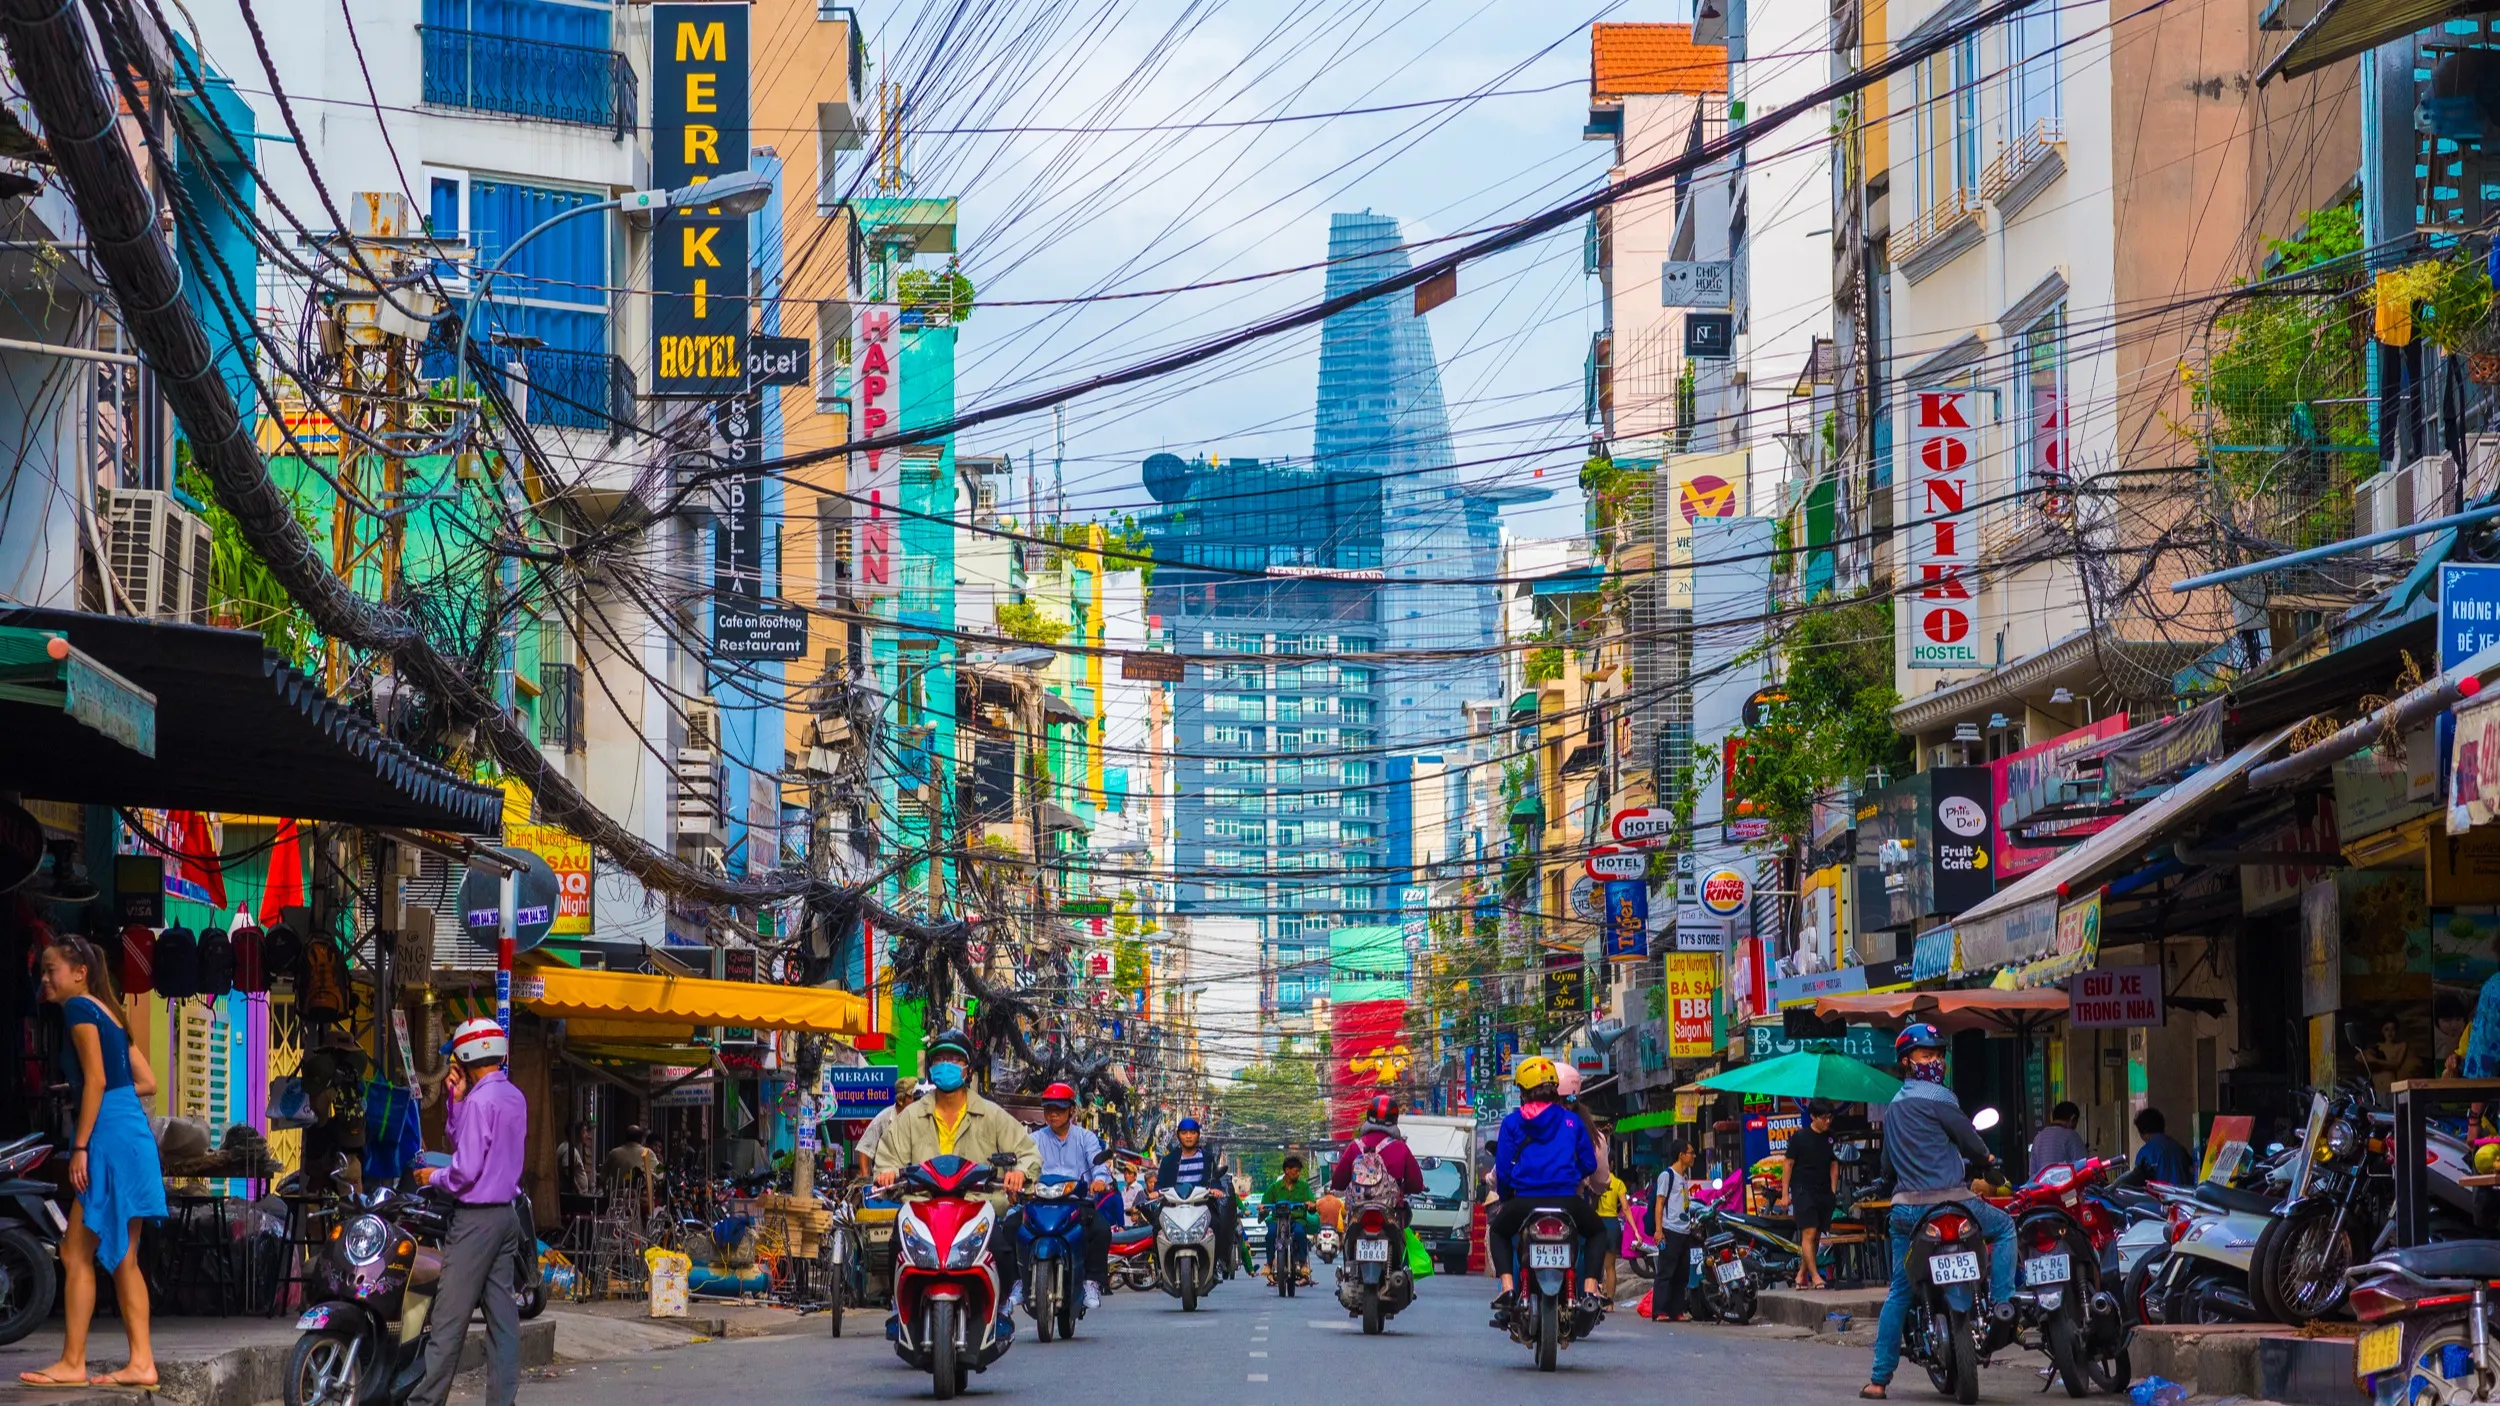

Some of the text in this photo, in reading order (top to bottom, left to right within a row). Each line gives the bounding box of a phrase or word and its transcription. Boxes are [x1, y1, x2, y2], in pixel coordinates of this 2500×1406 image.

[660, 336, 740, 378] HOTEL
[862, 312, 889, 471] HAPPY
[1917, 394, 1973, 643] KONIKO
[862, 490, 889, 584] INN
[2452, 598, 2491, 620] KHÔNG
[719, 614, 802, 631] Cafe on Rooftop
[750, 630, 770, 639] and
[2458, 627, 2473, 651] ĐỂ
[720, 640, 801, 651] Restaurant
[1915, 647, 1975, 660] HOSTEL
[1624, 821, 1671, 832] HOTEL
[1956, 817, 1980, 828] Deli
[1941, 845, 1973, 858] Fruit
[546, 851, 588, 869] SÁU
[1597, 858, 1640, 868] HOTEL
[1941, 858, 1972, 870] Cafe
[1706, 880, 1744, 889] BURGER
[1704, 889, 1744, 901] KING
[560, 895, 590, 916] Night
[126, 907, 152, 917] VISA
[1617, 897, 1641, 950] Tiger
[1680, 934, 1720, 945] TY'S STORE
[1552, 971, 1577, 982] Gym
[1560, 984, 1569, 994] &
[1671, 978, 1689, 995] BÀ
[2084, 972, 2142, 996] GIỮ XE
[1554, 996, 1575, 1008] Spa
[2076, 997, 2156, 1021] TRONG NHÀ
[1675, 1021, 1702, 1042] Saigon
[1674, 1045, 1690, 1054] 135
[834, 1072, 884, 1082] MERAKI
[867, 1088, 889, 1100] Hotel
[1477, 1105, 1510, 1122] Spa
[1767, 1118, 1802, 1130] DOUBLE
[1768, 1127, 1799, 1141] PATT
[1361, 1241, 1383, 1250] 59-P1
[1536, 1245, 1564, 1256] 64-H1
[1536, 1255, 1565, 1266] 7492
[1938, 1256, 1970, 1269] 60-B5
[2032, 1259, 2063, 1271] 54-R4
[1935, 1268, 1977, 1282] 684.25
[2032, 1269, 2064, 1283] 1656
